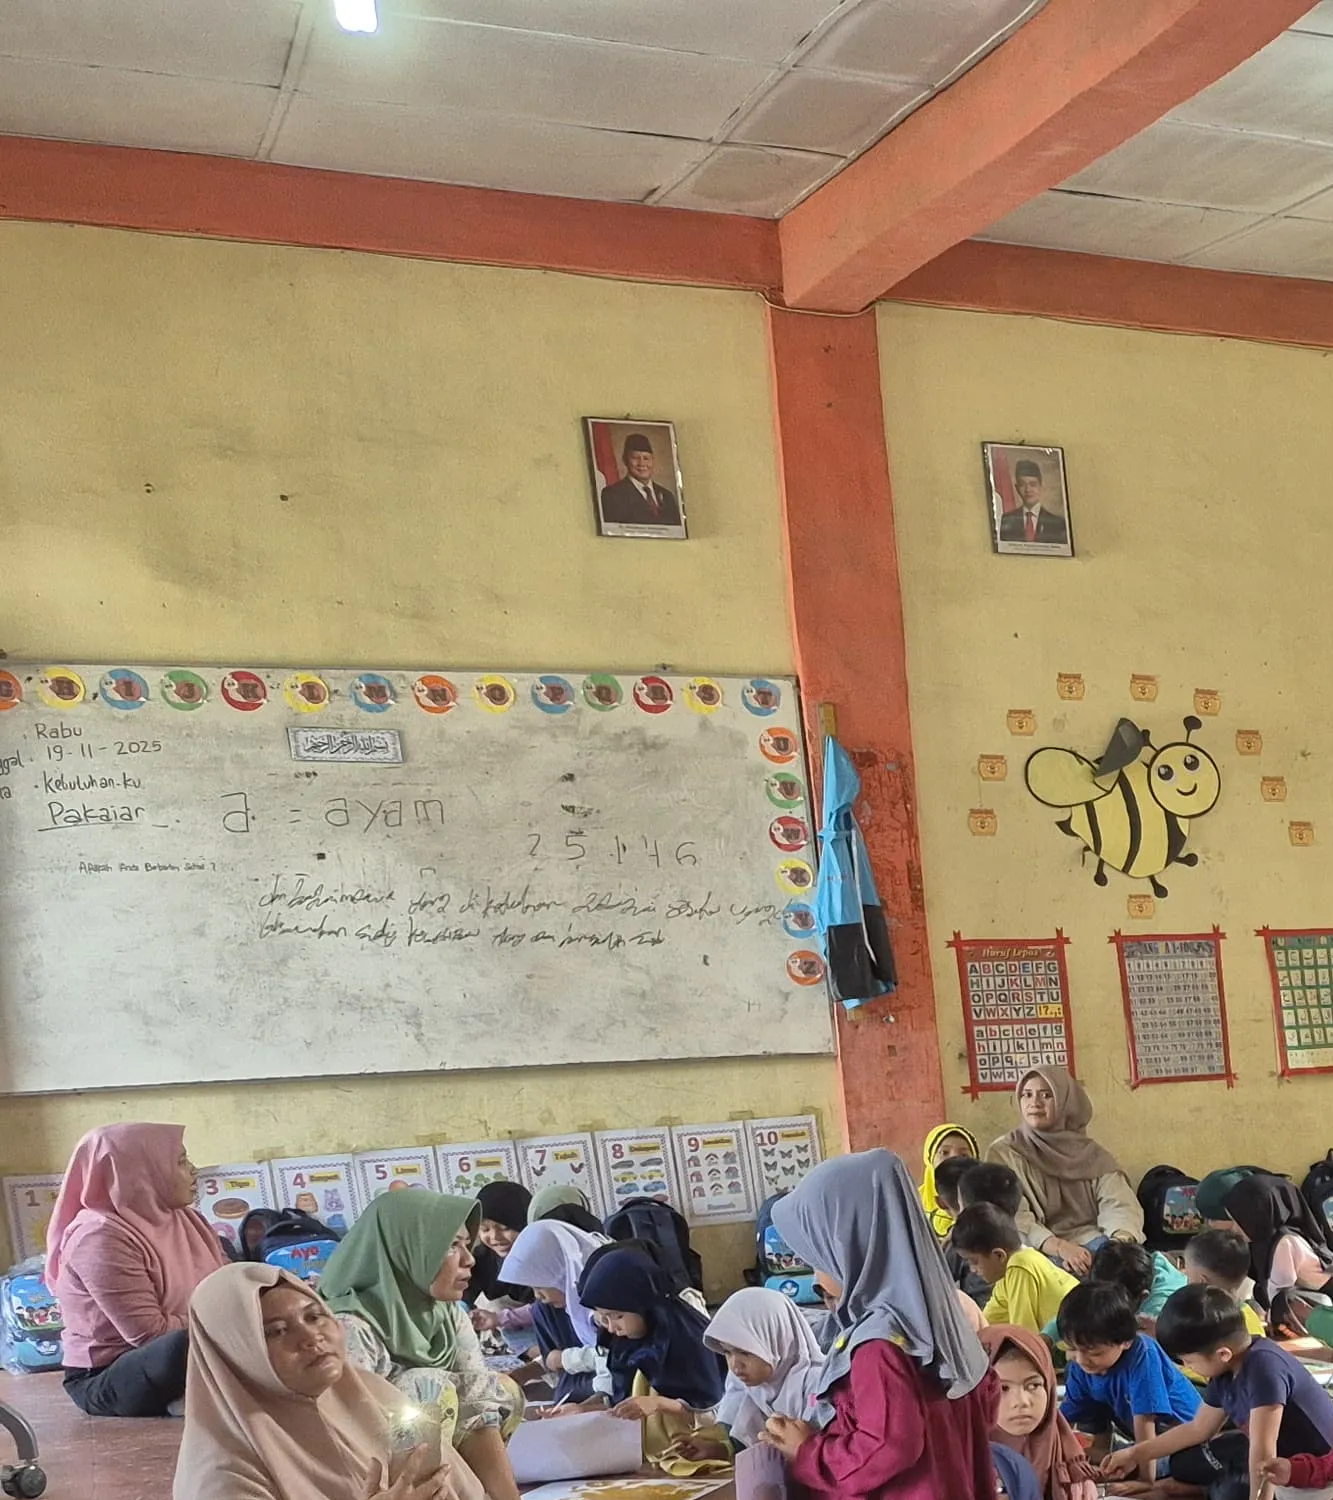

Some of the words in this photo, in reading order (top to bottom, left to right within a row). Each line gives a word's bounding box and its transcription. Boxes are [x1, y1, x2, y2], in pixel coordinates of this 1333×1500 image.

[35, 721, 82, 739] Rabu
[565, 835, 588, 860] 5
[687, 1136, 700, 1152] 9
[754, 1131, 779, 1147] 10
[534, 1150, 547, 1166] 7
[611, 1143, 624, 1159] 8
[458, 1156, 471, 1172] 6
[375, 1164, 388, 1181] 5
[205, 1180, 219, 1195] 3
[293, 1173, 307, 1189] 4
[25, 1190, 40, 1206] 1
